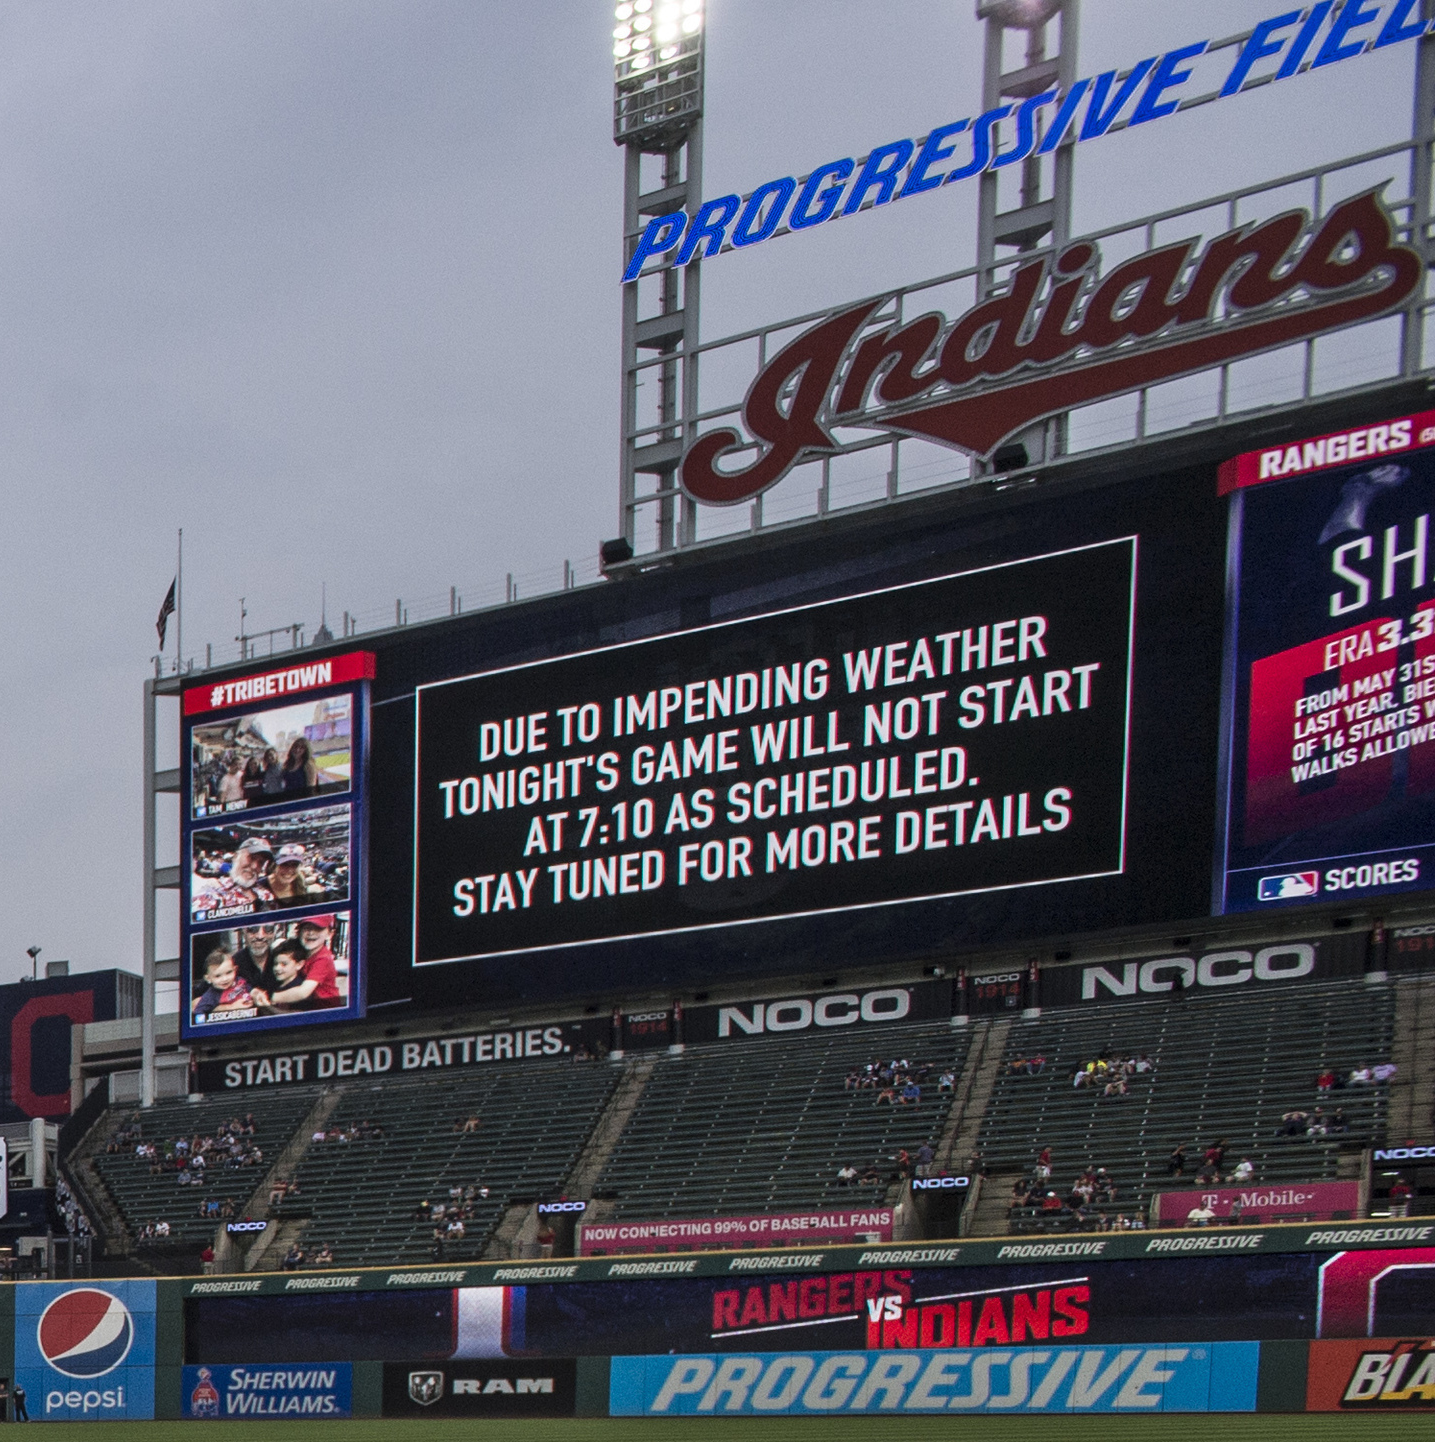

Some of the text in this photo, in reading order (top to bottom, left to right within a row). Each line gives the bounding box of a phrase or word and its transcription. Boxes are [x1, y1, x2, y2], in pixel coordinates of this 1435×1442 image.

[620, 0, 1435, 285] PROGRESSIVE FIEL
[680, 179, 1424, 506] Indians
[1258, 419, 1412, 480] RANGERS
[1323, 630, 1373, 672] ERA
[210, 661, 332, 708] #TRIBETOWN
[480, 614, 1048, 762] DUE TO IMPENDING WEATHER
[1295, 684, 1349, 718] FROM
[1352, 667, 1396, 699] MAY
[1291, 738, 1318, 762] OF
[1321, 730, 1345, 752] 16
[1348, 705, 1421, 743] STARTS
[1293, 708, 1341, 740] LAST
[439, 661, 1101, 820] TONIGHT'S GAME WILL NOT START
[1291, 747, 1358, 784] WALKS
[523, 746, 980, 857] AT 7:10 AS SCHEDULED.
[453, 786, 1073, 918] STAY TUNED FOR MORE DETAILS
[1324, 858, 1420, 891] SCORES
[974, 973, 1021, 985] NOCO
[1081, 943, 1315, 1000] NOCO
[976, 982, 1020, 999] 1914
[628, 1012, 667, 1022] NOCO
[718, 988, 911, 1038] NOCO
[226, 1026, 571, 1088] START DEAD BATTERIES.
[913, 1176, 970, 1191] NOCO
[538, 1201, 586, 1214] NOCO
[227, 1219, 267, 1232] NOCO
[585, 1212, 890, 1241] NOW CONNECTING 99% OF BASEBALL FANS
[1305, 1225, 1433, 1245] PROGRESSIVE
[858, 1247, 962, 1266] PROGRESSIVE
[997, 1241, 1107, 1259] PROGRESSIVE
[1146, 1234, 1265, 1252] PROGRESSIVE
[493, 1265, 579, 1280] PROGRESSIVE
[608, 1260, 699, 1277] PROGRESSIVE
[730, 1254, 826, 1271] PROGRESSIVE
[191, 1280, 263, 1294] PROGRESSIVE
[285, 1275, 362, 1290] PROGRESSIVE
[386, 1270, 467, 1286] PROGRESSIVE
[712, 1269, 913, 1330] RANGERS
[867, 1295, 903, 1323] VS
[865, 1285, 1091, 1350] INDIANS
[228, 1368, 337, 1391] SHERWIN
[452, 1378, 555, 1395] RAM
[651, 1347, 1189, 1412] PROGRESSIVE
[46, 1385, 123, 1414] pepsi
[226, 1392, 336, 1414] WILLIAMS
